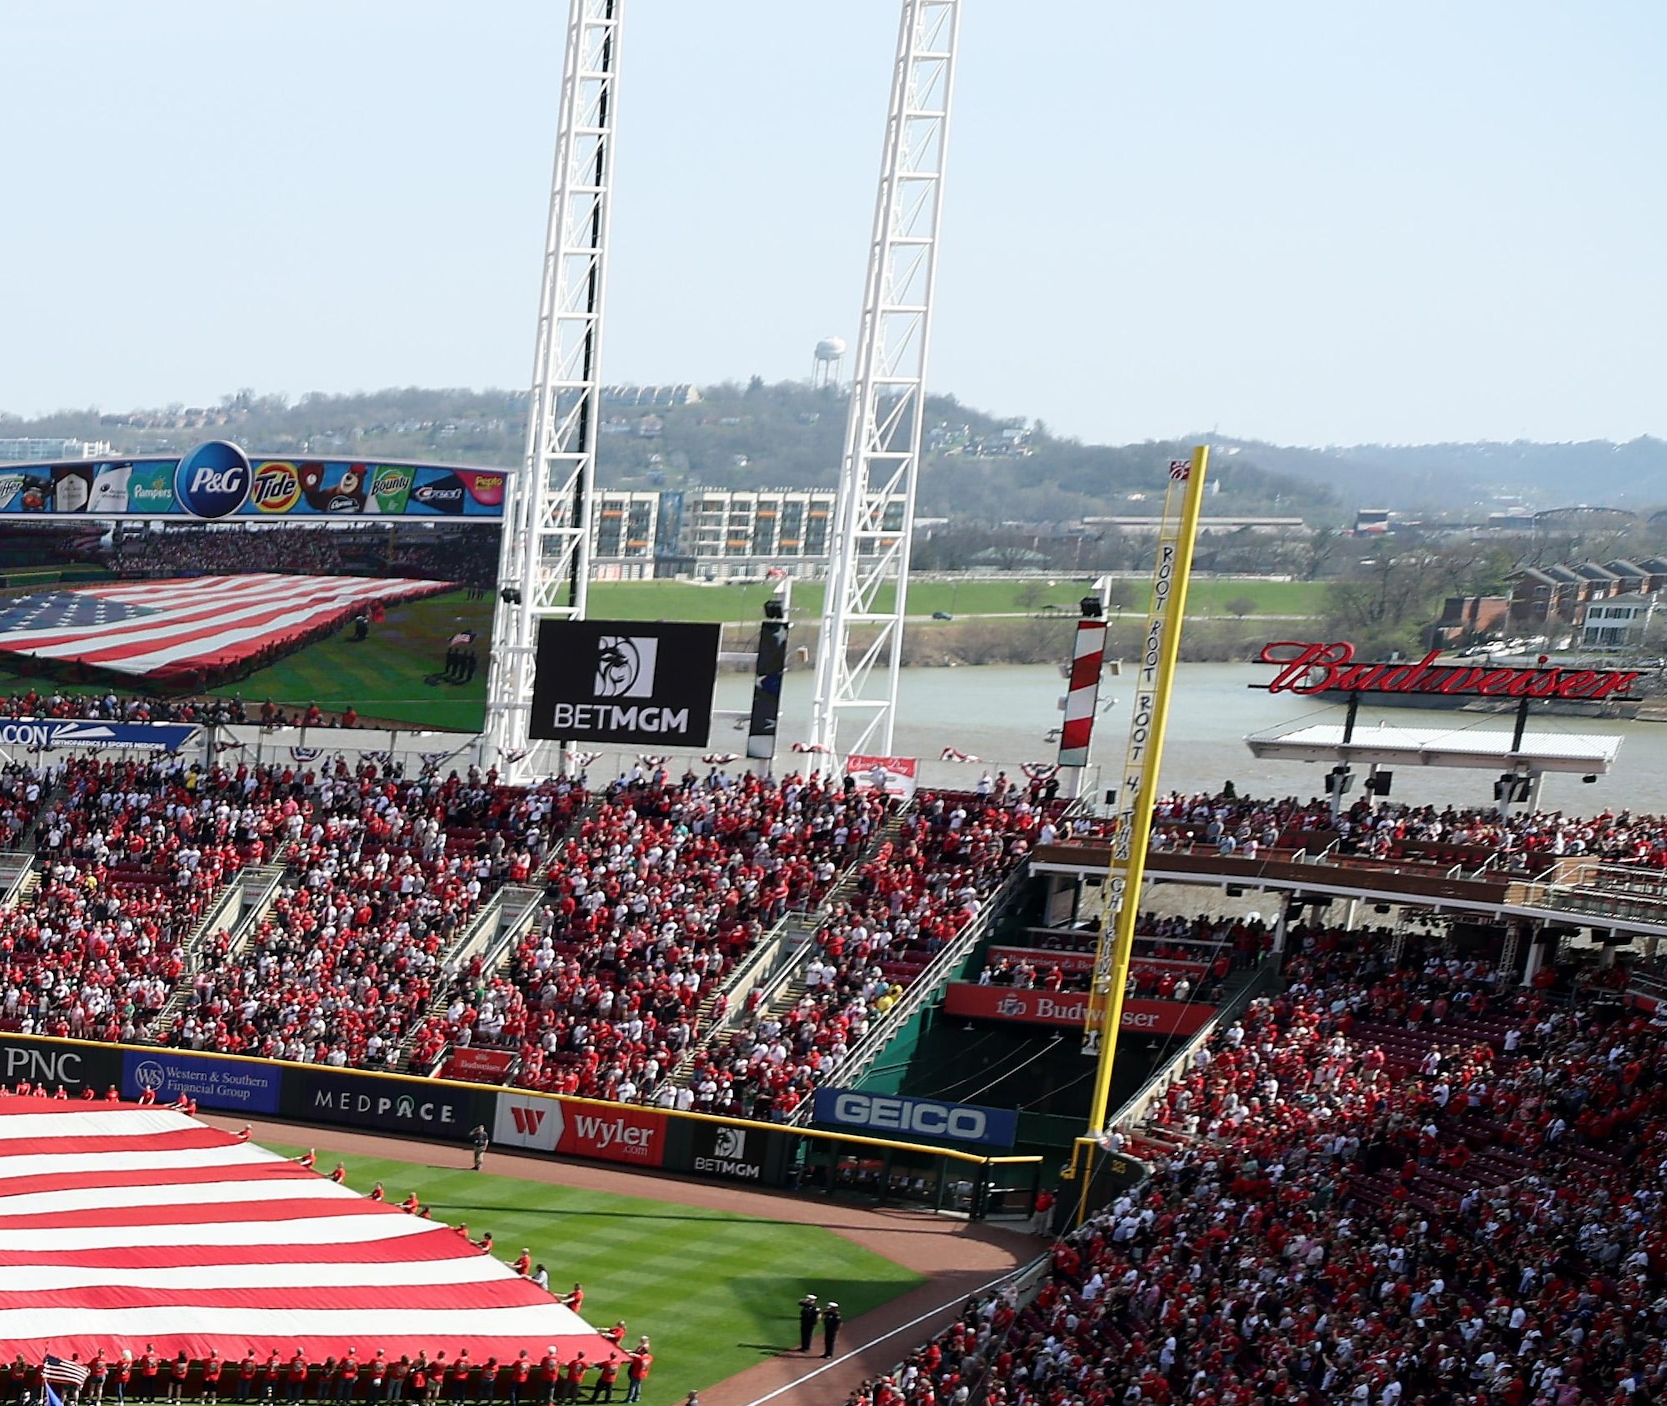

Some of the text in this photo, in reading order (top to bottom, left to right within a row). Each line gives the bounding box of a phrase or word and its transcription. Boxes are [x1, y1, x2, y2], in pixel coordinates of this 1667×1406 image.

[134, 483, 173, 500] Pampers
[190, 467, 243, 494] P&G
[255, 473, 298, 504] Tide
[371, 475, 411, 496] Bounty
[1155, 547, 1172, 611] ROOT
[1143, 621, 1161, 683] ROOT
[1261, 641, 1639, 698] Budweiser
[553, 702, 690, 734] BETMGM
[1132, 696, 1150, 761] ROOT
[4, 1047, 82, 1084] PNC
[166, 1066, 268, 1088] Western & Southern
[167, 1080, 251, 1101] Financial Group
[315, 1090, 455, 1124] MEDPACE
[574, 1114, 655, 1150] Wyler
[834, 1093, 987, 1140] GEICO
[695, 1156, 760, 1179] BETMGM
